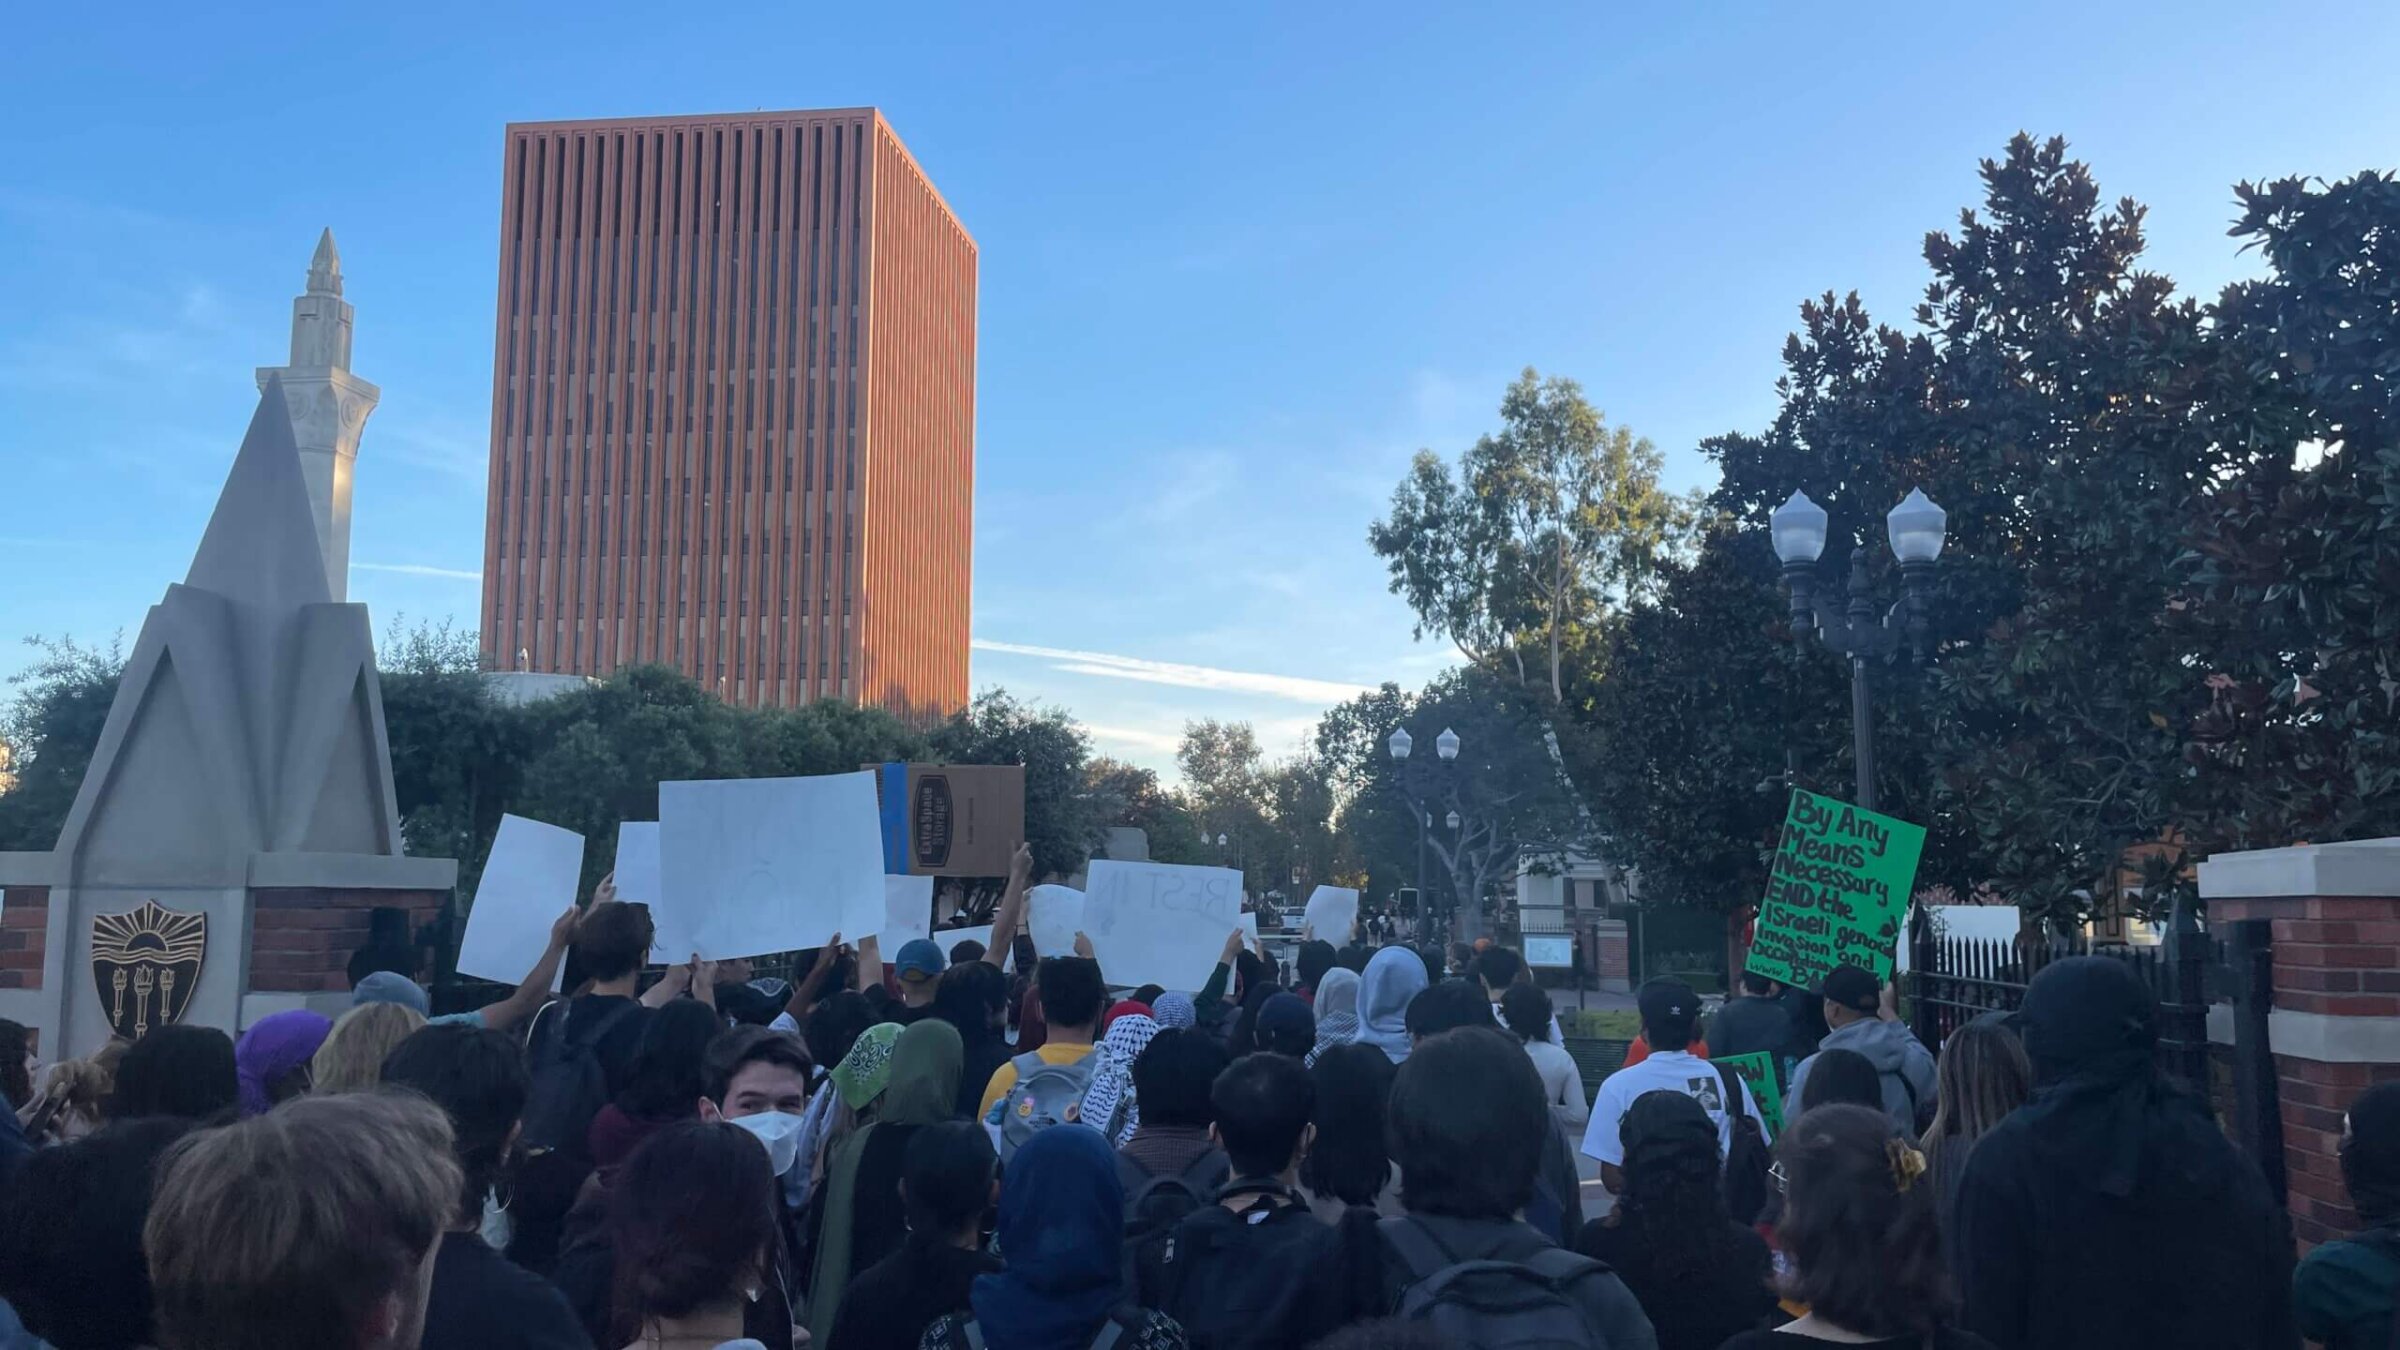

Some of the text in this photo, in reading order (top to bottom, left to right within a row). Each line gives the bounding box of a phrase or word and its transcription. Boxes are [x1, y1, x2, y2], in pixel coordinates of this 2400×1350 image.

[933, 797, 947, 846] Storage
[1791, 793, 1889, 857] By Any
[1779, 823, 1865, 869] Means
[1765, 876, 1857, 922] END the
[1773, 852, 1889, 908] Necessary
[1837, 950, 1874, 970] and
